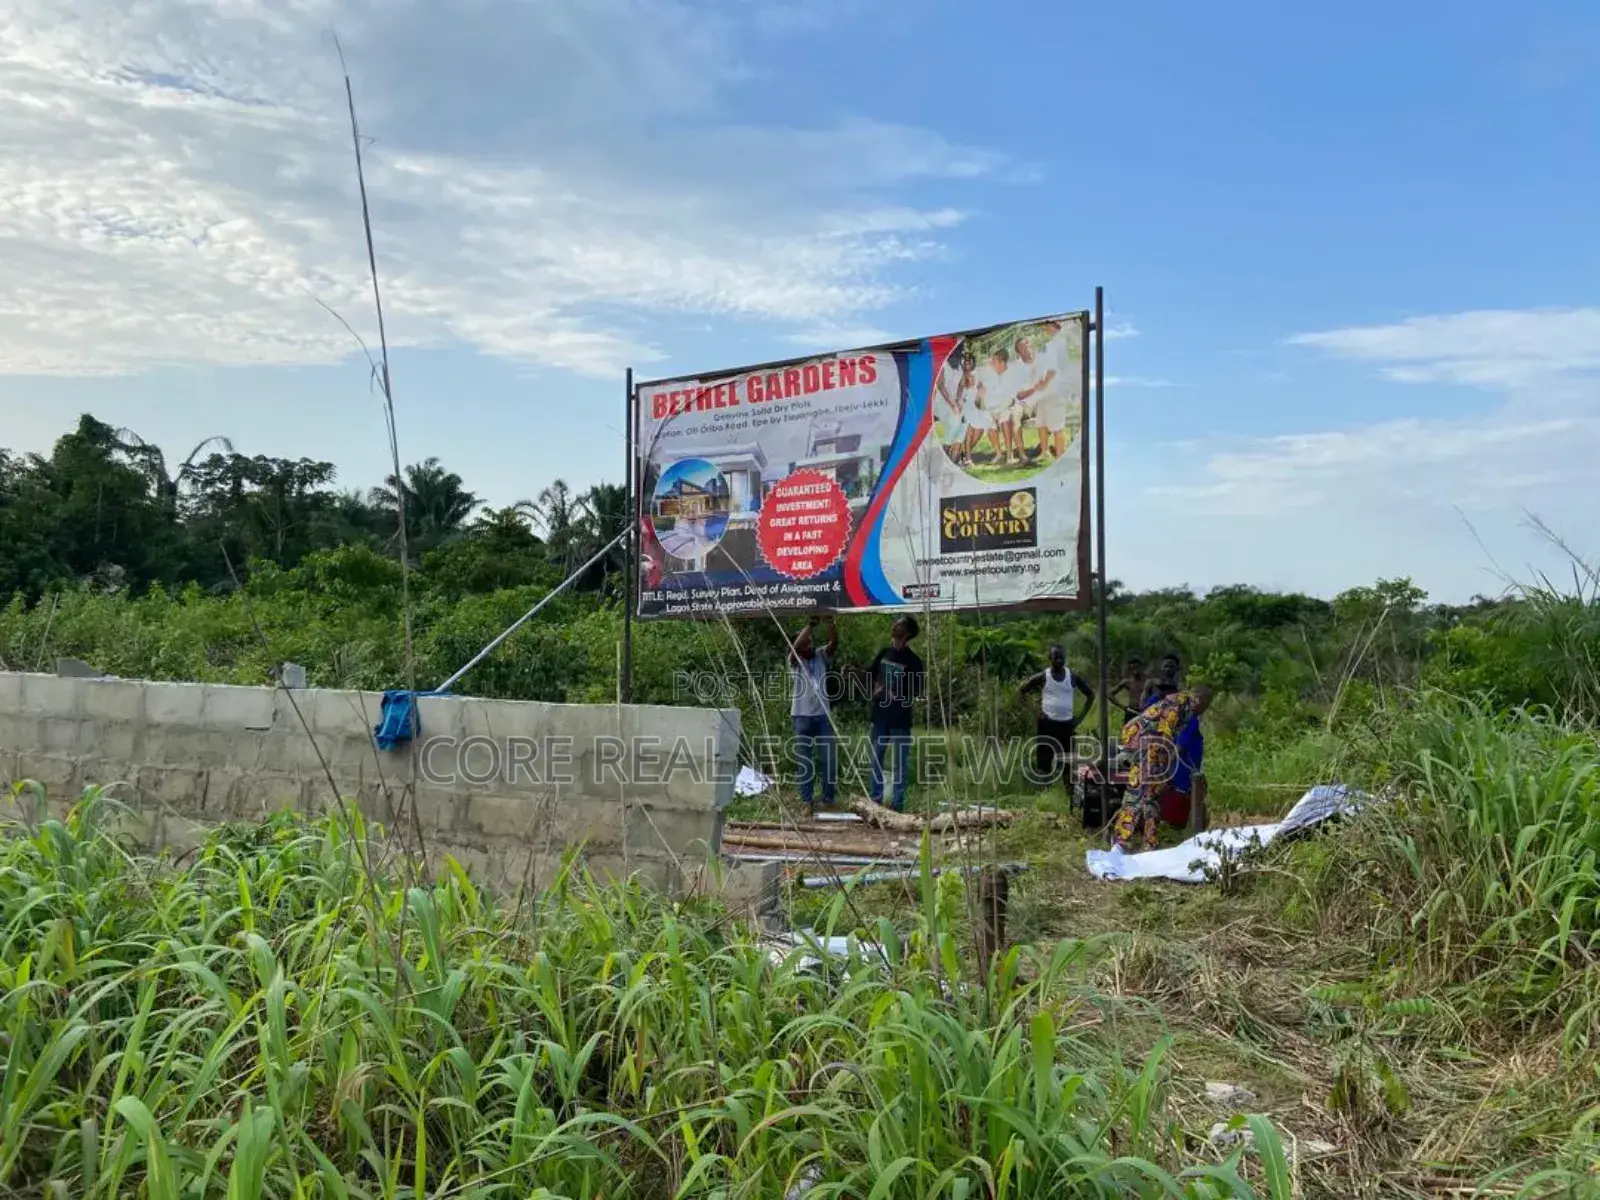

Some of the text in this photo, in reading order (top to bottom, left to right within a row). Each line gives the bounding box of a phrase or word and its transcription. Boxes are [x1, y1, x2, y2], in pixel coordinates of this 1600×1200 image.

[652, 355, 877, 420] BETHEL GARDENS
[713, 400, 811, 422] Genuine Solid Dry Plots
[770, 414, 782, 425] by
[776, 482, 832, 498] GUARANTEED
[770, 513, 838, 528] GREAT RETURNS
[943, 506, 1008, 524] SWEET
[783, 529, 823, 541] IN A FAST
[944, 518, 1031, 539] COUNTRY
[776, 544, 829, 557] DEVELOPING
[916, 549, 1066, 566] sweetcountryestate@gmail.com
[791, 560, 813, 571] AREA
[939, 563, 1041, 578] www.sweetcountry.ng
[691, 589, 720, 600] Survey
[769, 583, 778, 594] of
[780, 582, 830, 595] Assignment
[832, 580, 841, 592] &
[666, 603, 690, 614] Lagos
[691, 602, 713, 611] State
[796, 596, 817, 607] plan
